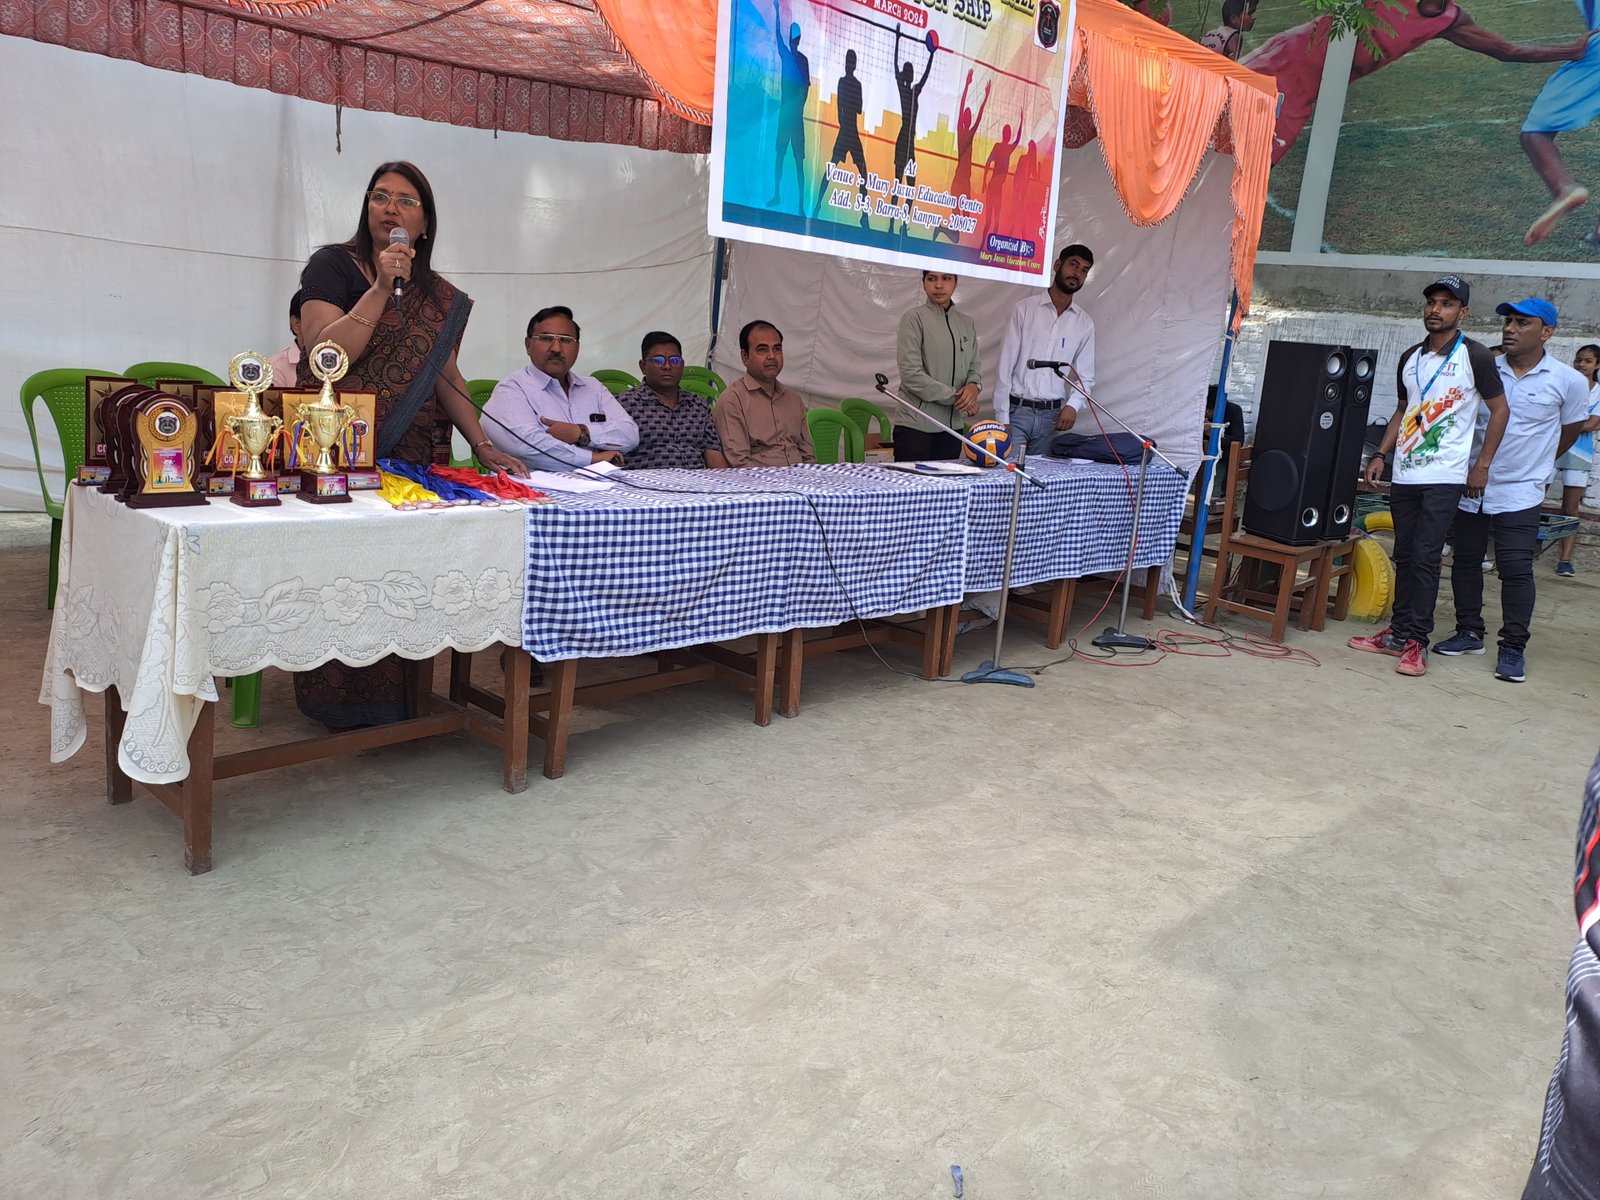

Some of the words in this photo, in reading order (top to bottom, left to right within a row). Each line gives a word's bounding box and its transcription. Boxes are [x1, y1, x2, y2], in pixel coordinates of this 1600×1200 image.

[873, 0, 902, 18] MARCH
[903, 9, 924, 26] 2024
[905, 159, 917, 176] At
[826, 162, 854, 185] Venue
[866, 173, 890, 196] Mary
[892, 179, 916, 200] Jusus
[918, 185, 957, 208] Education
[958, 194, 983, 214] Centre
[829, 189, 851, 208] Add.
[912, 206, 942, 229] kanpur
[949, 214, 977, 233] 208027
